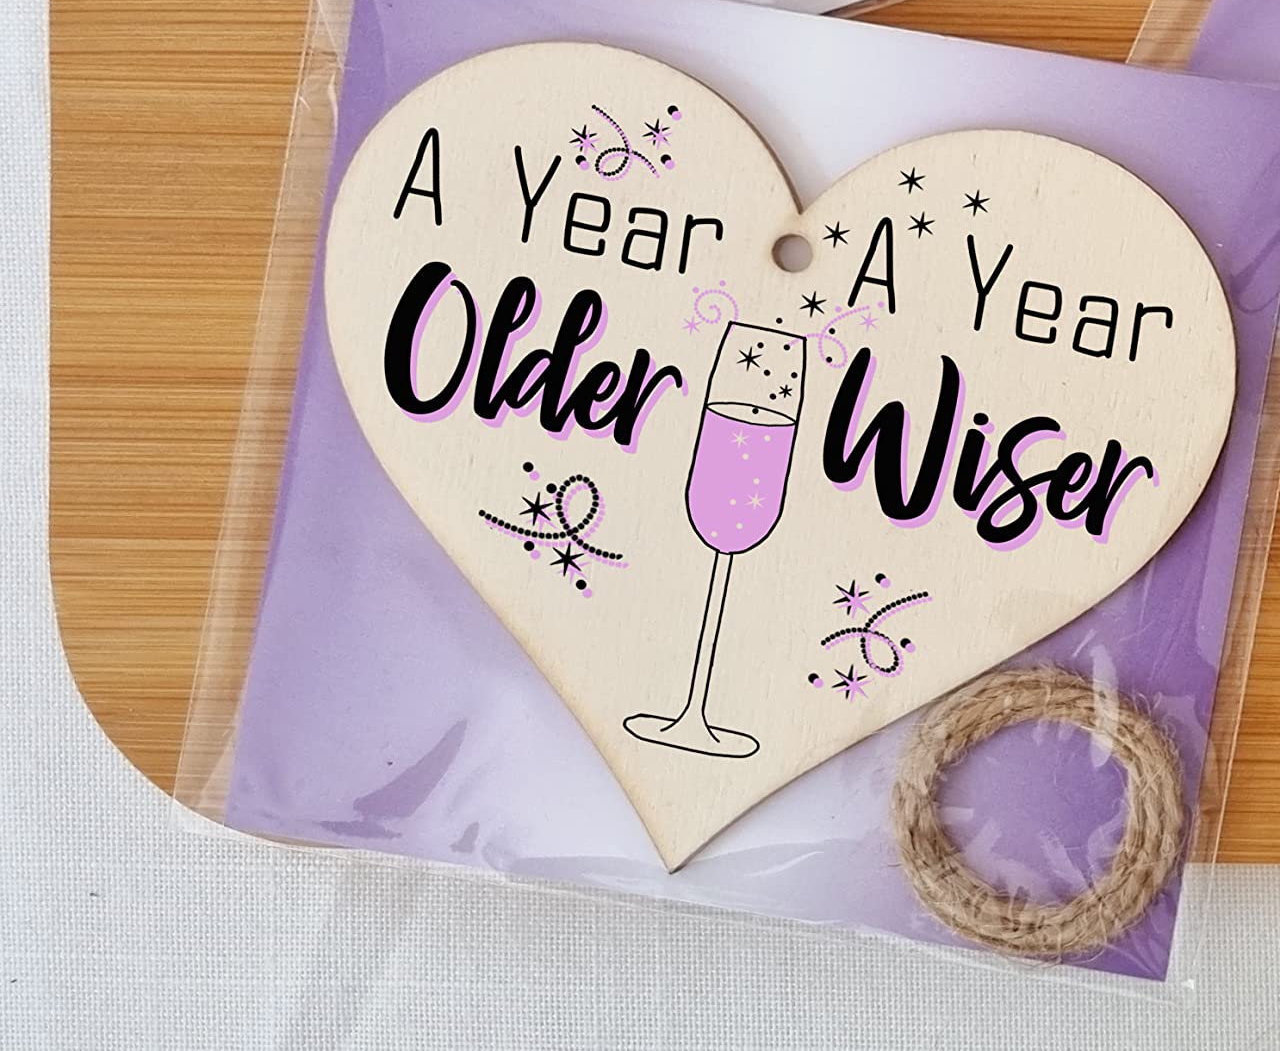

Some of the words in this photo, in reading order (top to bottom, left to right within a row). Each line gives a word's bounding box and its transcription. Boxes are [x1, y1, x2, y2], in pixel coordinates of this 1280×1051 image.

[393, 127, 443, 226] A
[514, 145, 723, 274] Year
[384, 261, 689, 454] Older
[847, 218, 897, 314] A
[967, 235, 1174, 362] Year
[822, 347, 1159, 552] Wiser
